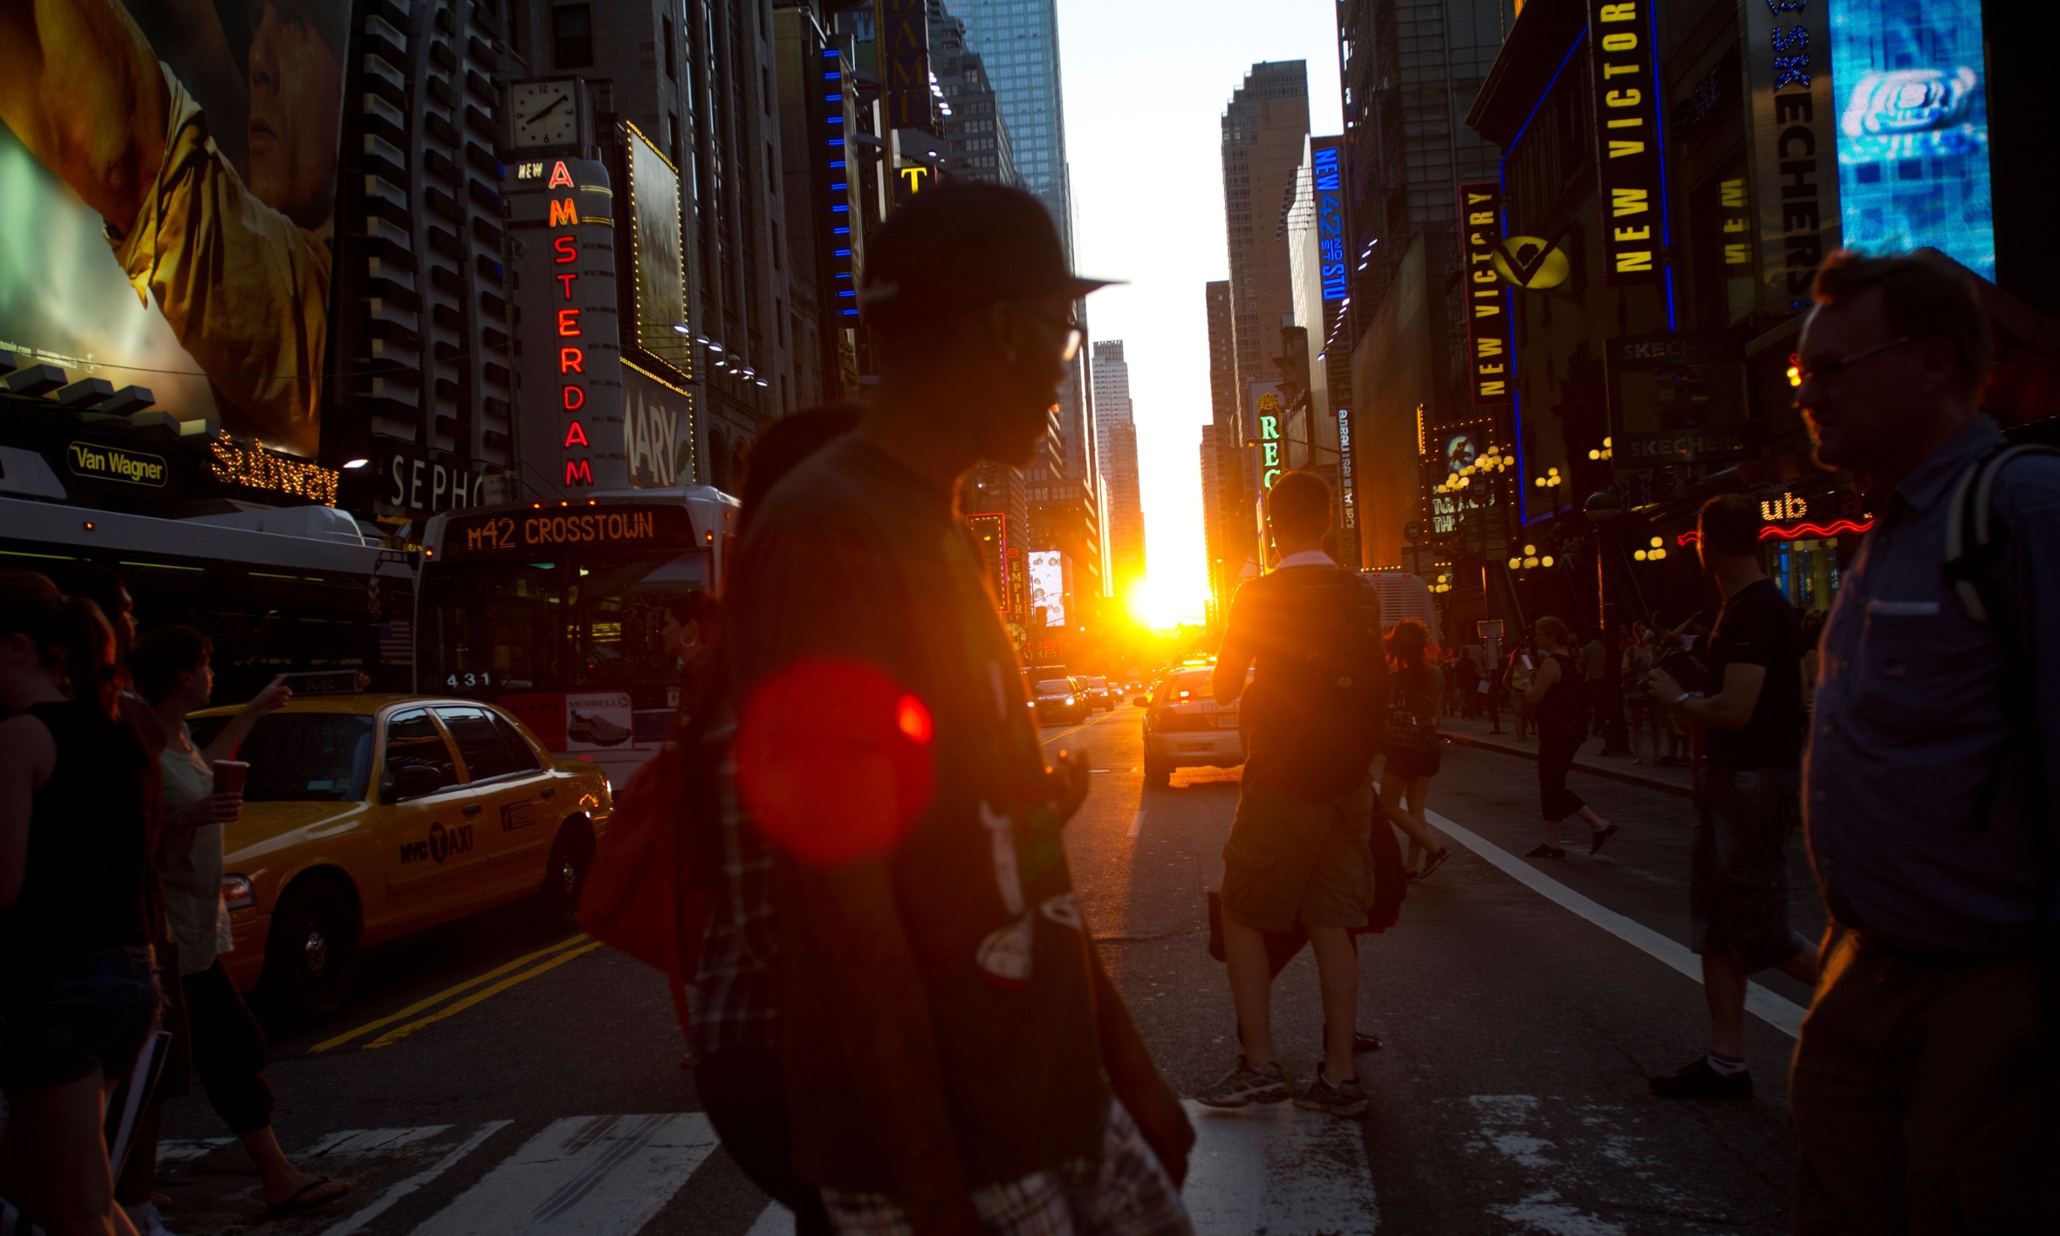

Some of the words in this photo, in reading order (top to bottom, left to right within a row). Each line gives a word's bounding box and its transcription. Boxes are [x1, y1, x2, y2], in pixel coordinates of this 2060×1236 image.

[1600, 1, 1645, 160] VICTOR
[1314, 147, 1340, 191] NEW
[1771, 25, 1824, 297] SKECHERS
[1467, 192, 1501, 319] VICTORY
[1611, 188, 1653, 274] NEW
[518, 162, 543, 180] NEW
[548, 160, 594, 487] AMSTERDAM
[1477, 337, 1506, 397] NEW
[71, 446, 106, 472] Van
[108, 451, 163, 482] Wagner
[467, 517, 516, 550] M42
[524, 511, 654, 545] CROSSTOWN
[446, 672, 492, 688] 431
[568, 698, 618, 708] MERRELL
[400, 841, 429, 865] NYC
[429, 822, 474, 863] TAXI
